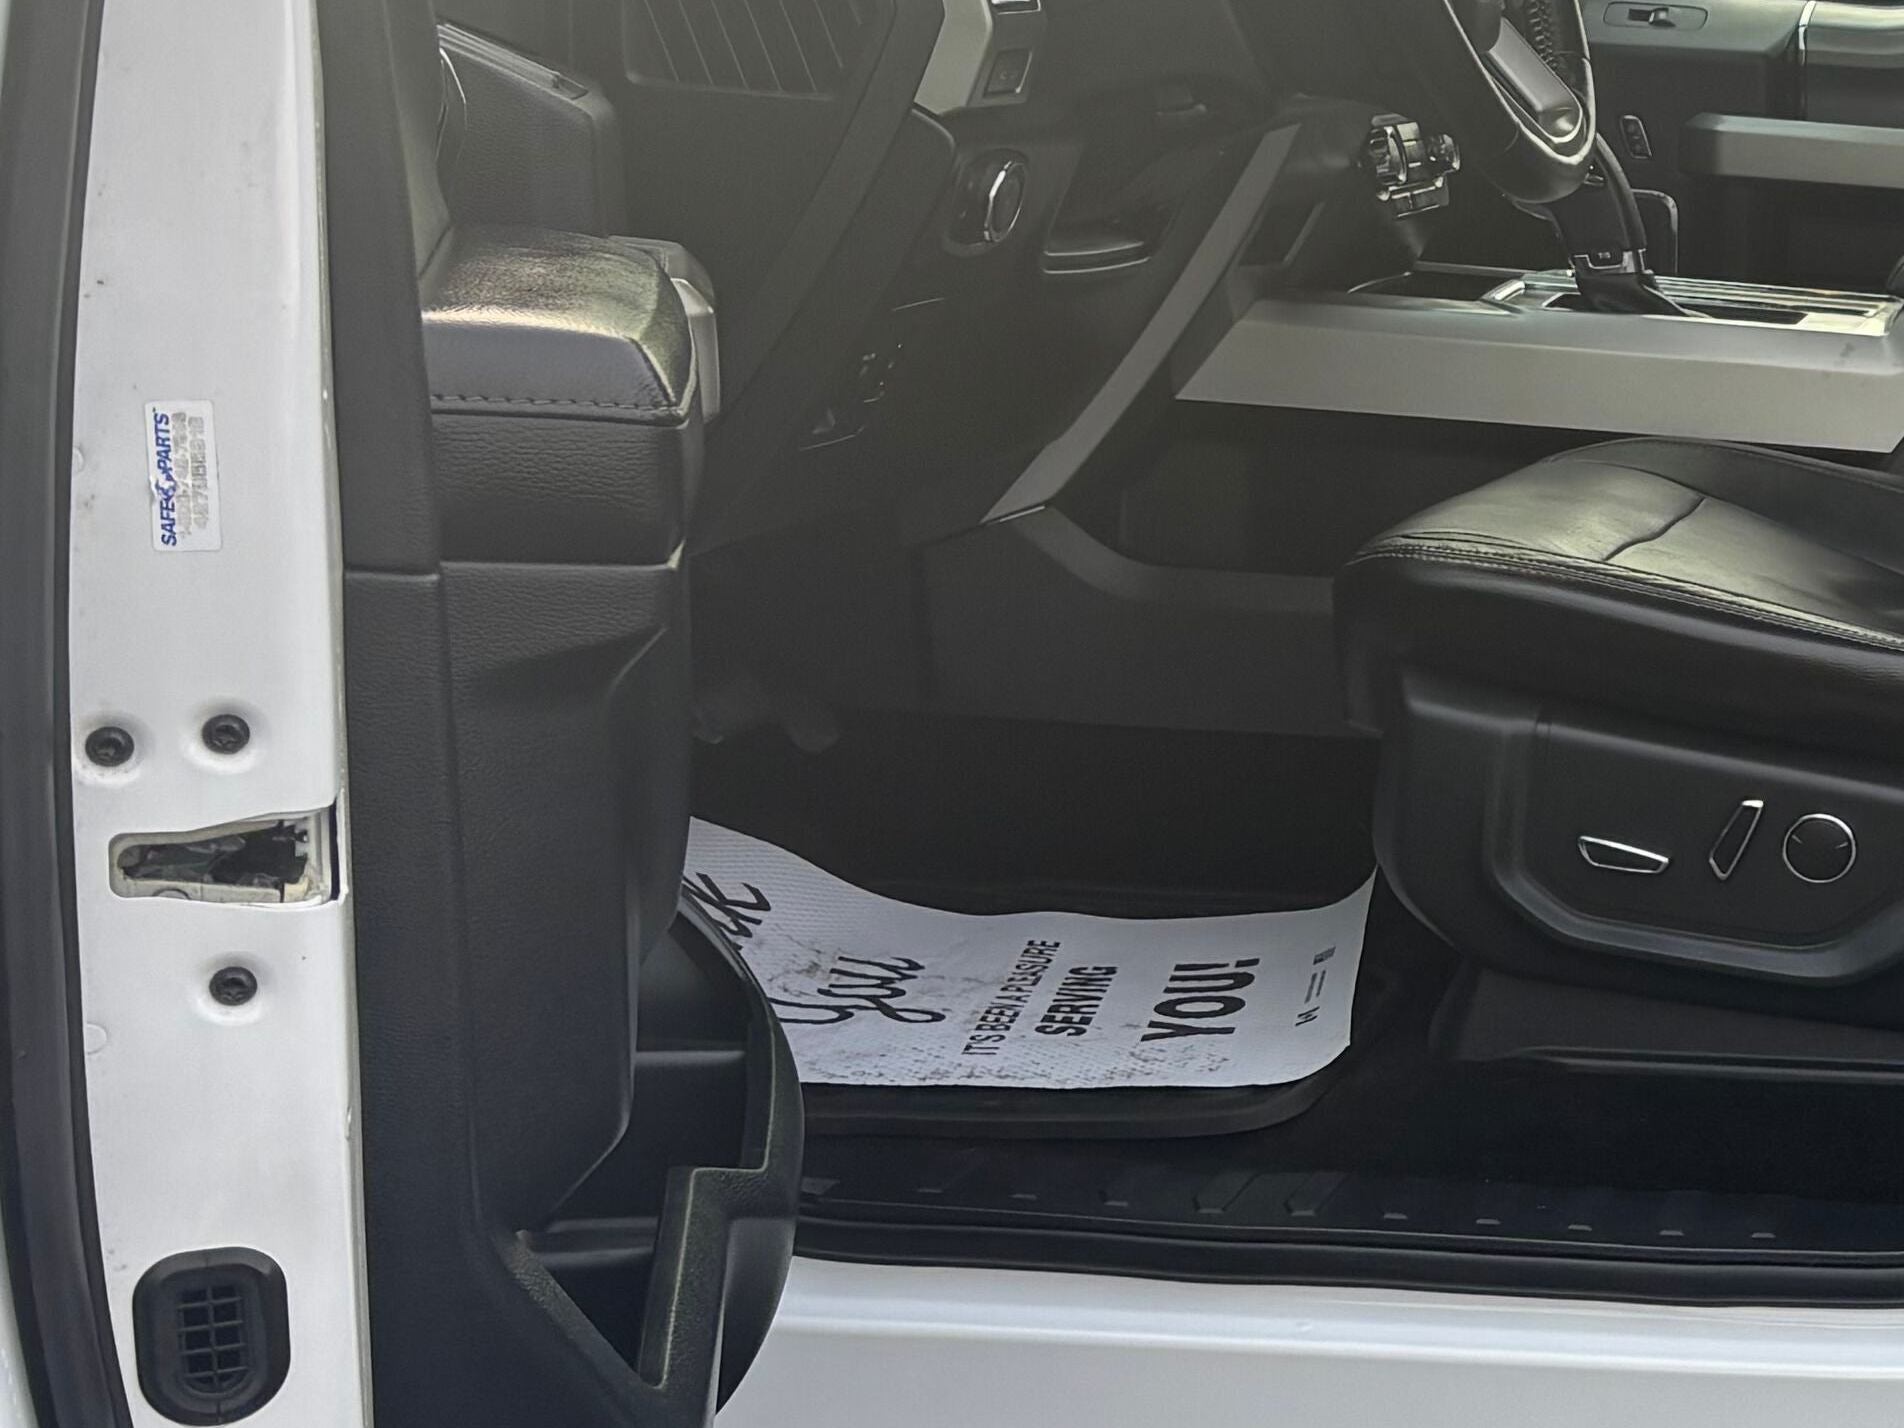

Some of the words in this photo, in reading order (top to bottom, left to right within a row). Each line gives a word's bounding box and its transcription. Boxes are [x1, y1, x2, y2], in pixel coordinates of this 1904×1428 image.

[999, 939, 1062, 993] PLEASURE
[974, 1002, 1025, 1032] BEEN
[1034, 966, 1119, 1037] SERVING
[1140, 957, 1261, 1043] YOU!
